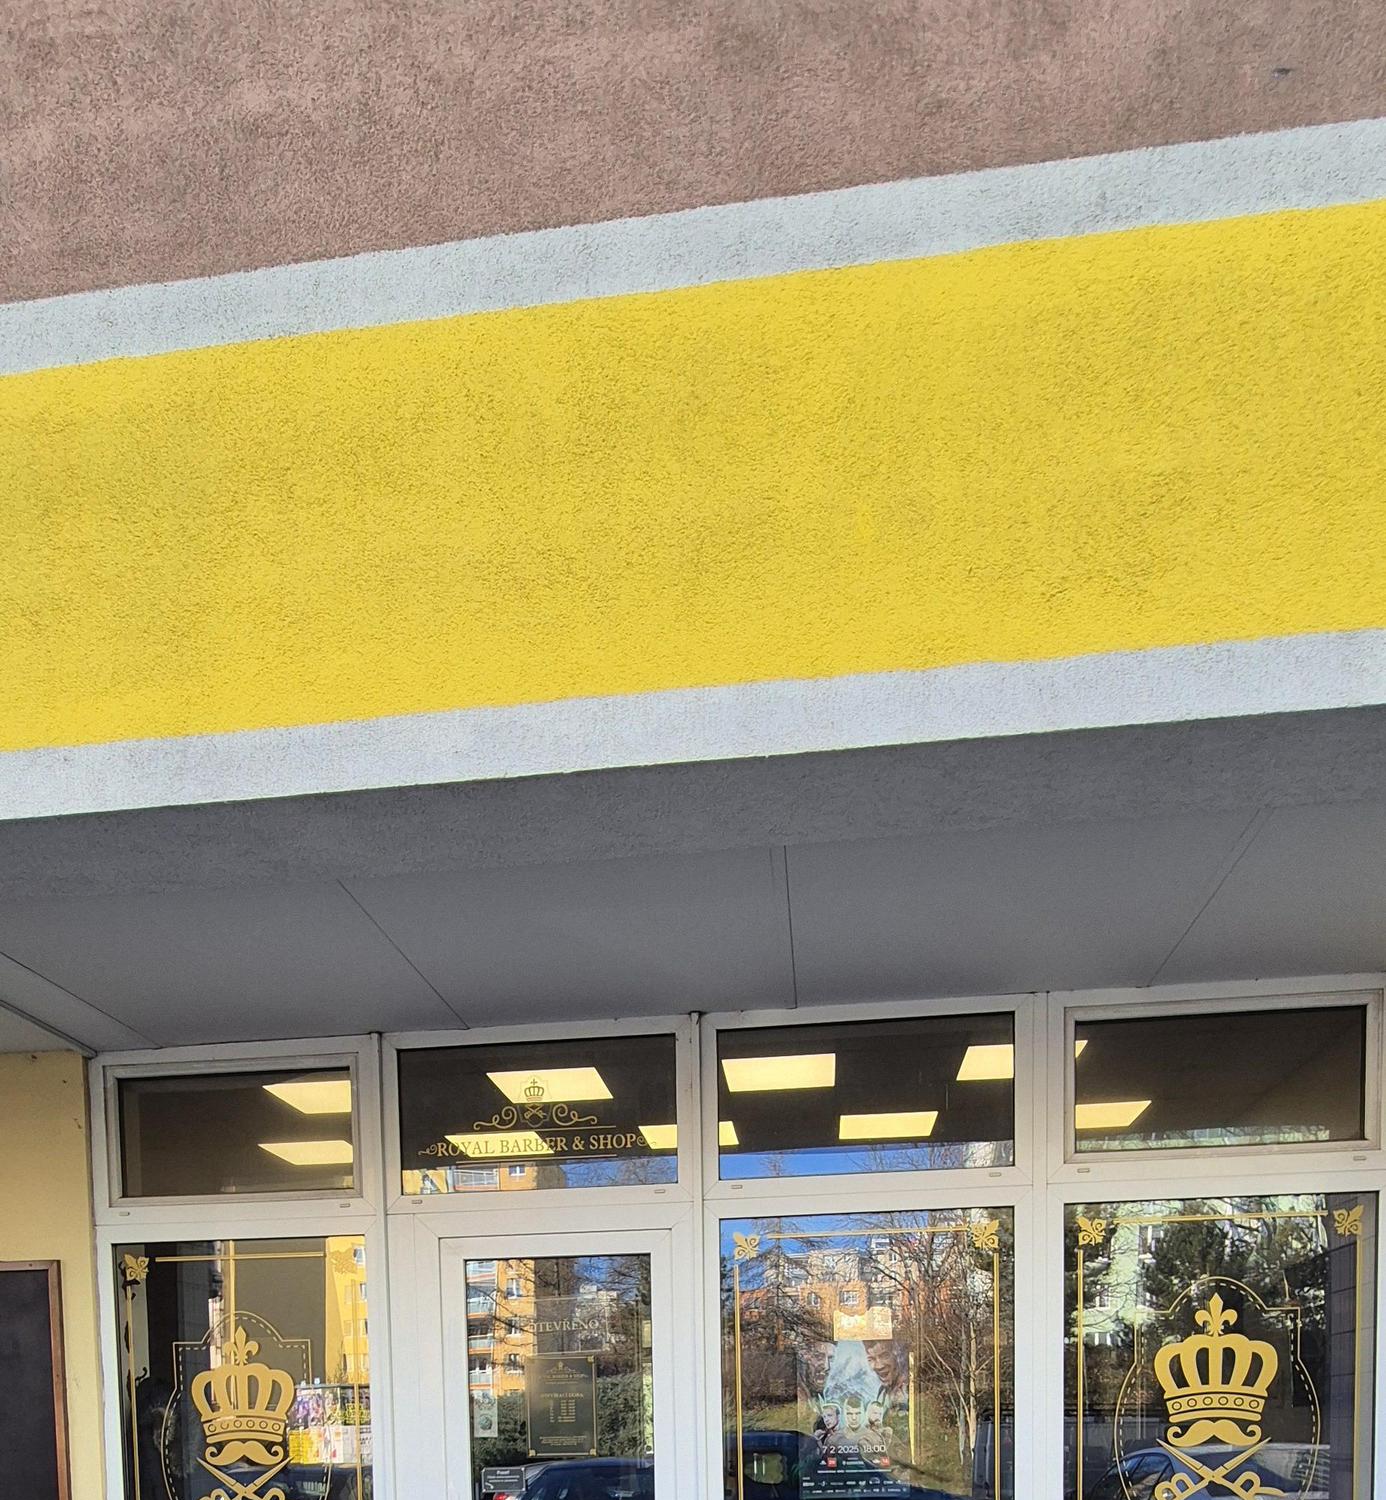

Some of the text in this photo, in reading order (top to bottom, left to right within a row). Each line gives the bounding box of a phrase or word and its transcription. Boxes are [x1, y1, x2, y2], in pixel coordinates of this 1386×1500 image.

[437, 1133, 637, 1157] ROYAL BARBER & SHOP
